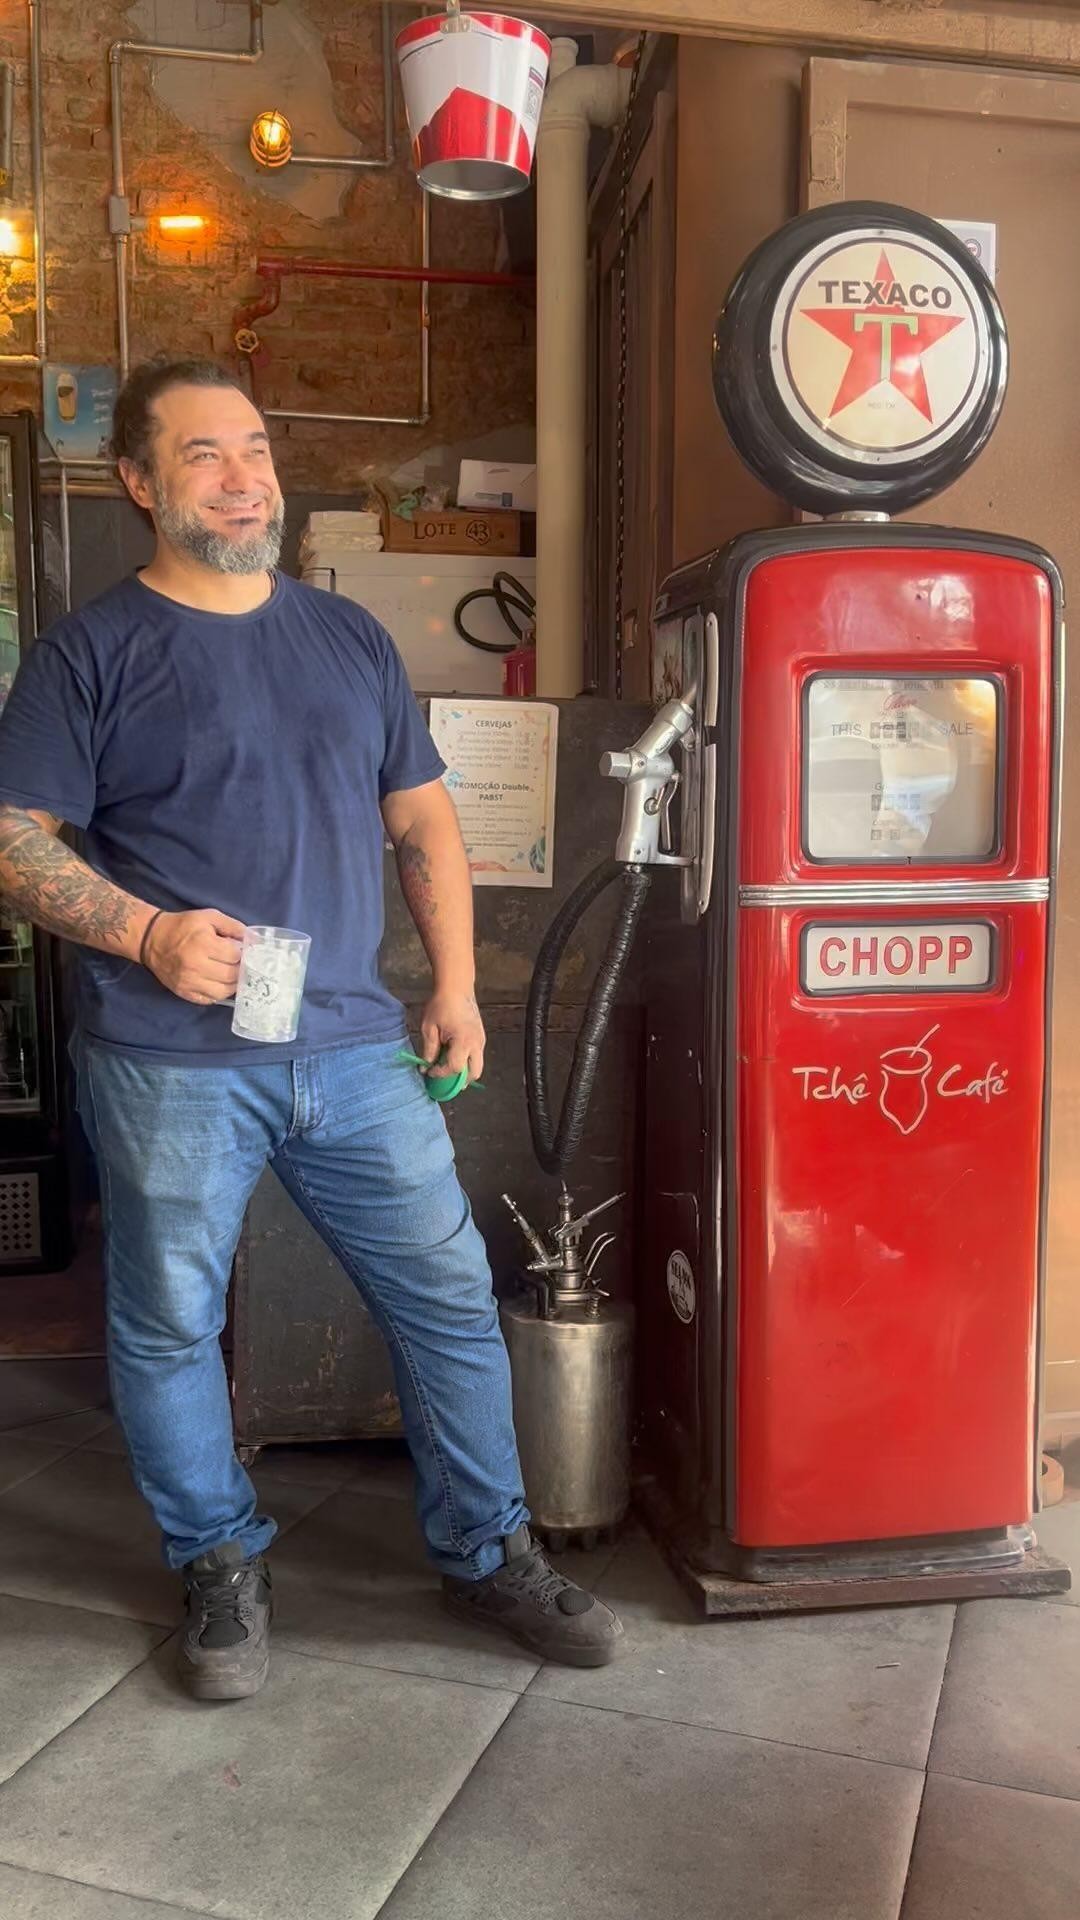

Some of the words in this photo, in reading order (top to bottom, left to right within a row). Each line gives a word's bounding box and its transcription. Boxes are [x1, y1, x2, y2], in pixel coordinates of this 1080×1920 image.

[818, 280, 952, 309] TEXACO
[854, 313, 919, 380] T
[414, 522, 456, 539] LOTE
[469, 523, 489, 541] 43
[475, 720, 513, 729] CERVEJAS
[831, 723, 862, 737] THIS
[454, 781, 500, 792] PROMOÇÃO
[819, 936, 973, 976] CHOPP
[792, 1066, 871, 1104] Tchê
[936, 1062, 1009, 1104] Café
